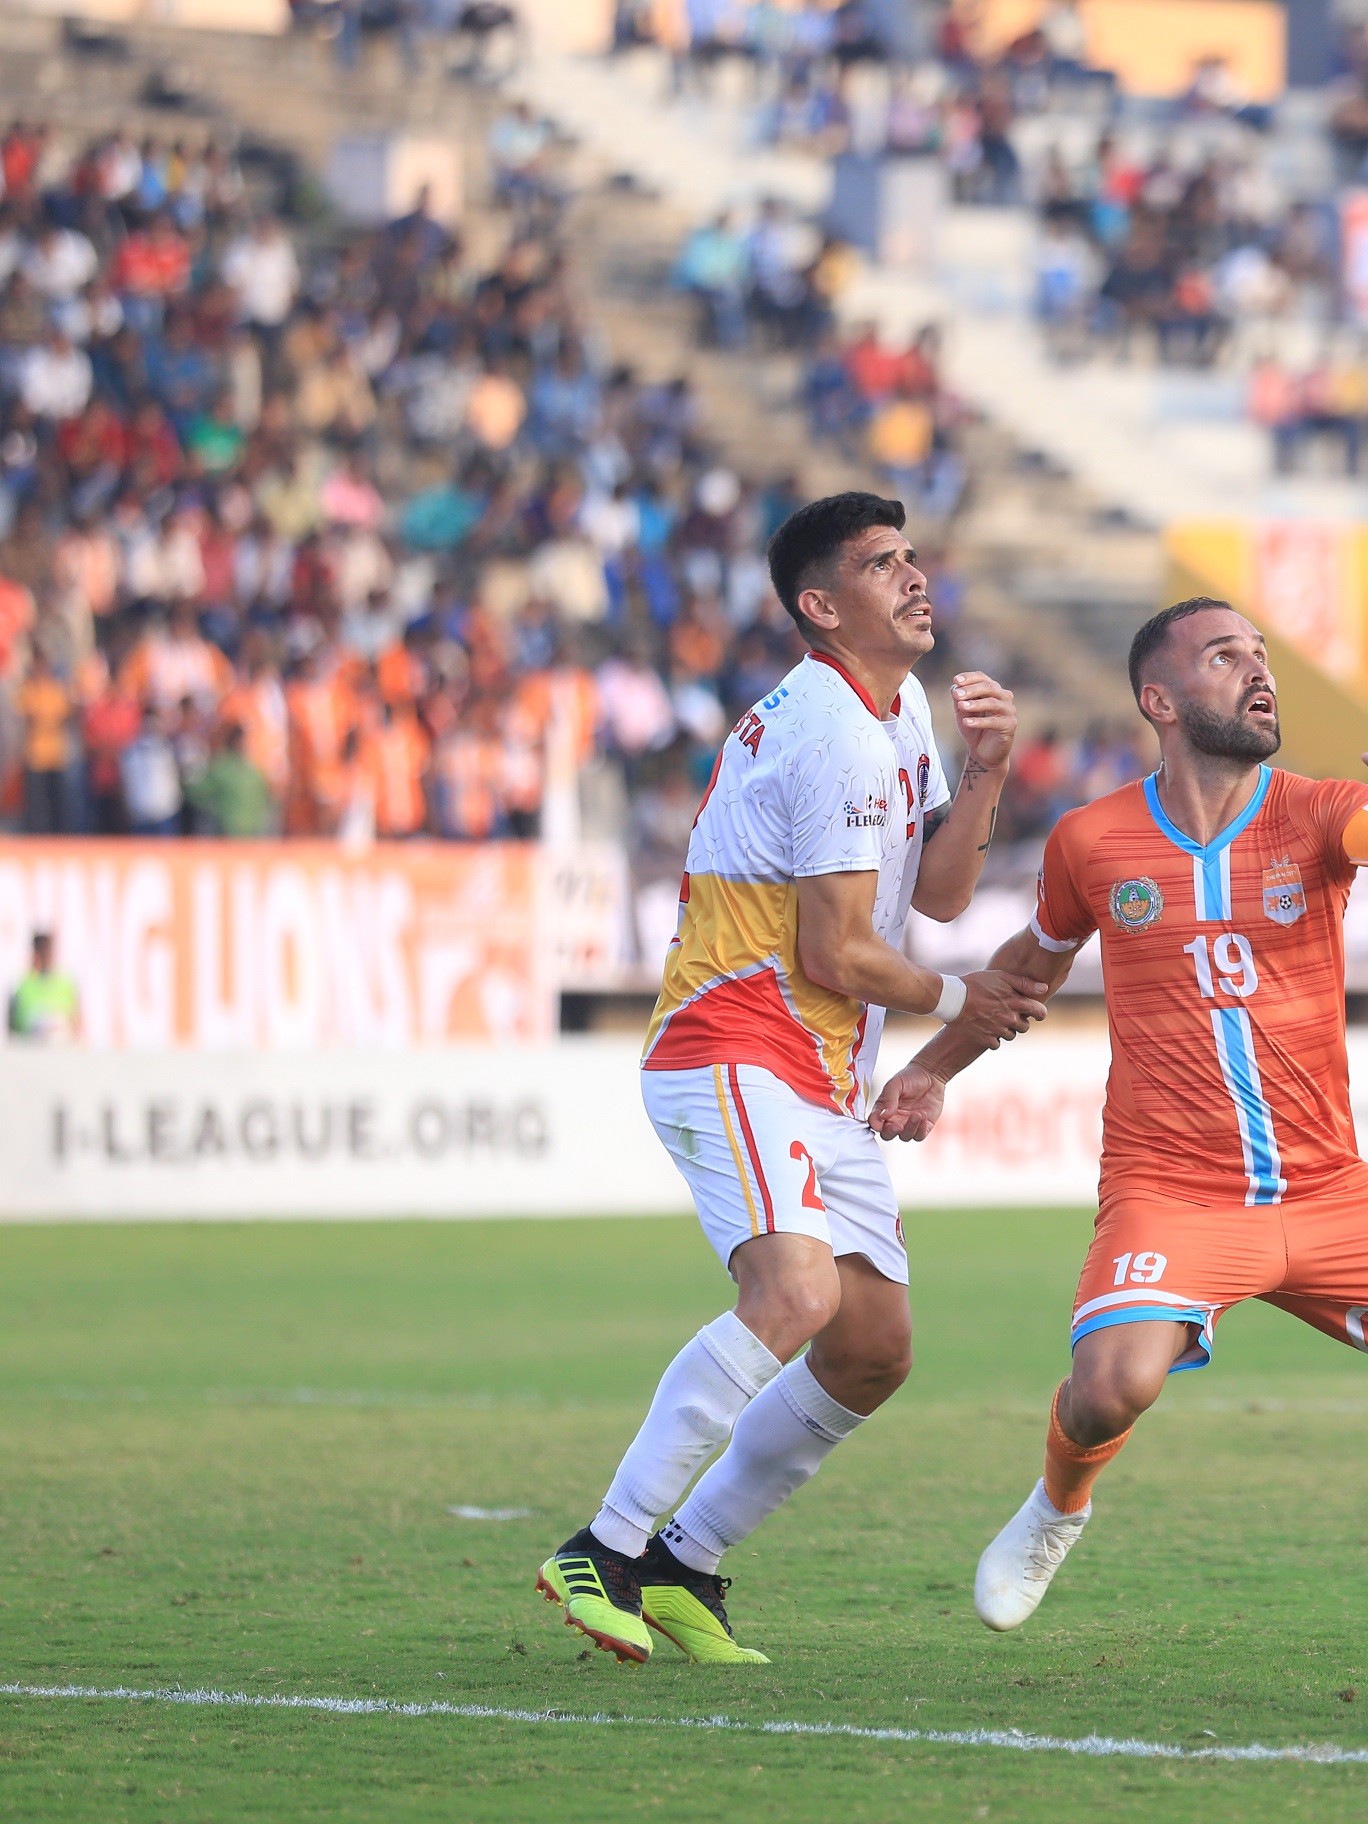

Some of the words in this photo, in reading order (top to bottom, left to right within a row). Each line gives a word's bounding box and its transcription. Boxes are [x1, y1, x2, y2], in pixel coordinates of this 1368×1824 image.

[1182, 932, 1259, 998] 19
[789, 1140, 826, 1212] 2
[1112, 1251, 1168, 1286] 19
